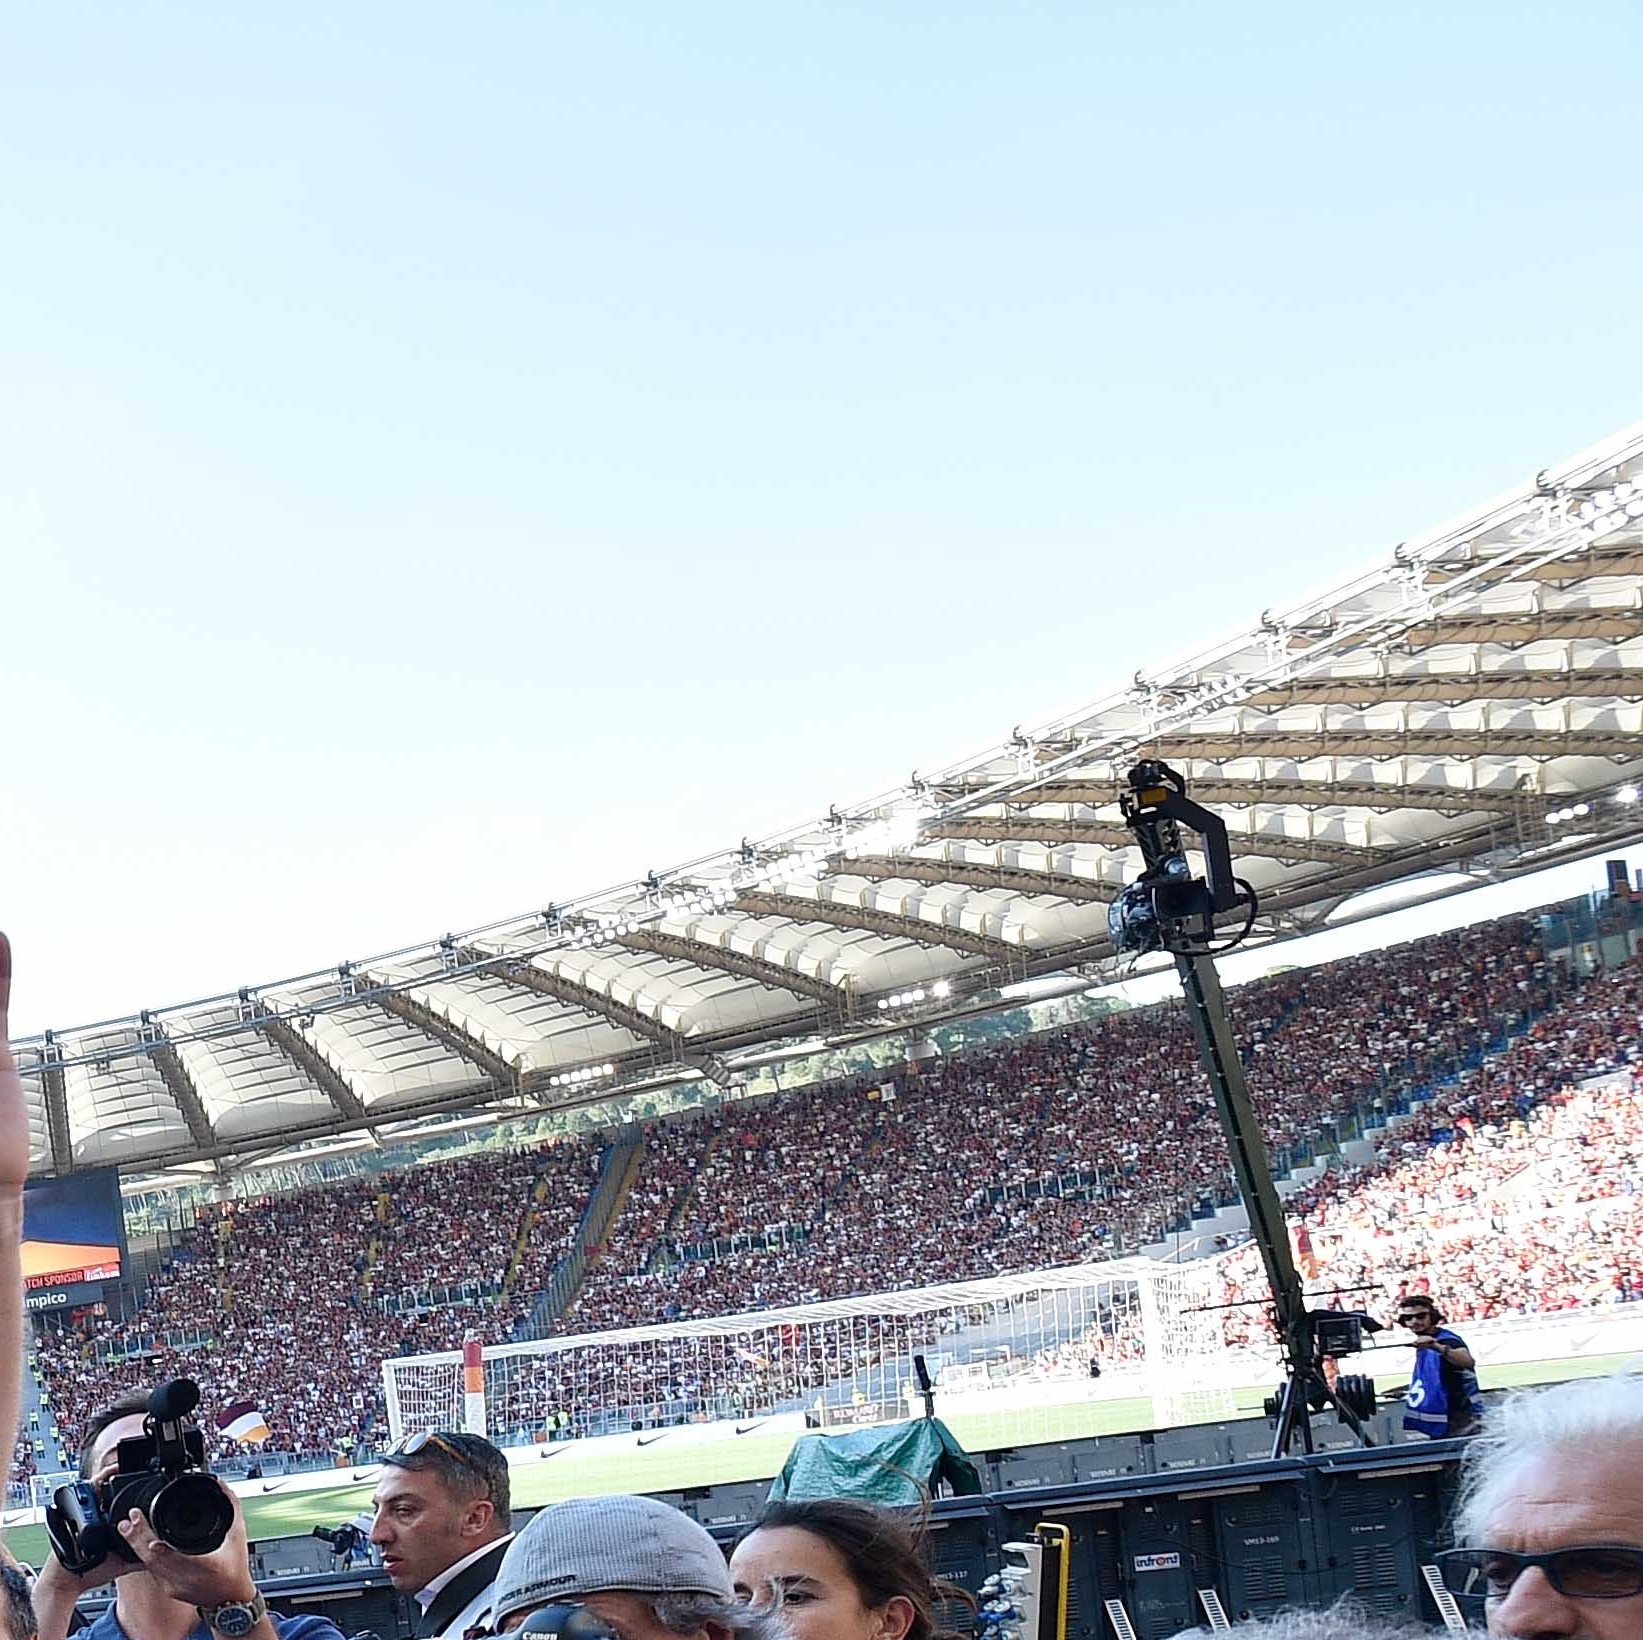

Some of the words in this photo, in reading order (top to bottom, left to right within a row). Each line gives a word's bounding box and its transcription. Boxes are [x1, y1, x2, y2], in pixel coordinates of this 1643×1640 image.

[23, 1292, 67, 1309] mpico
[1136, 1554, 1178, 1568] infront
[524, 1574, 576, 1592] ARMOUR
[522, 1631, 558, 1640] Canon
